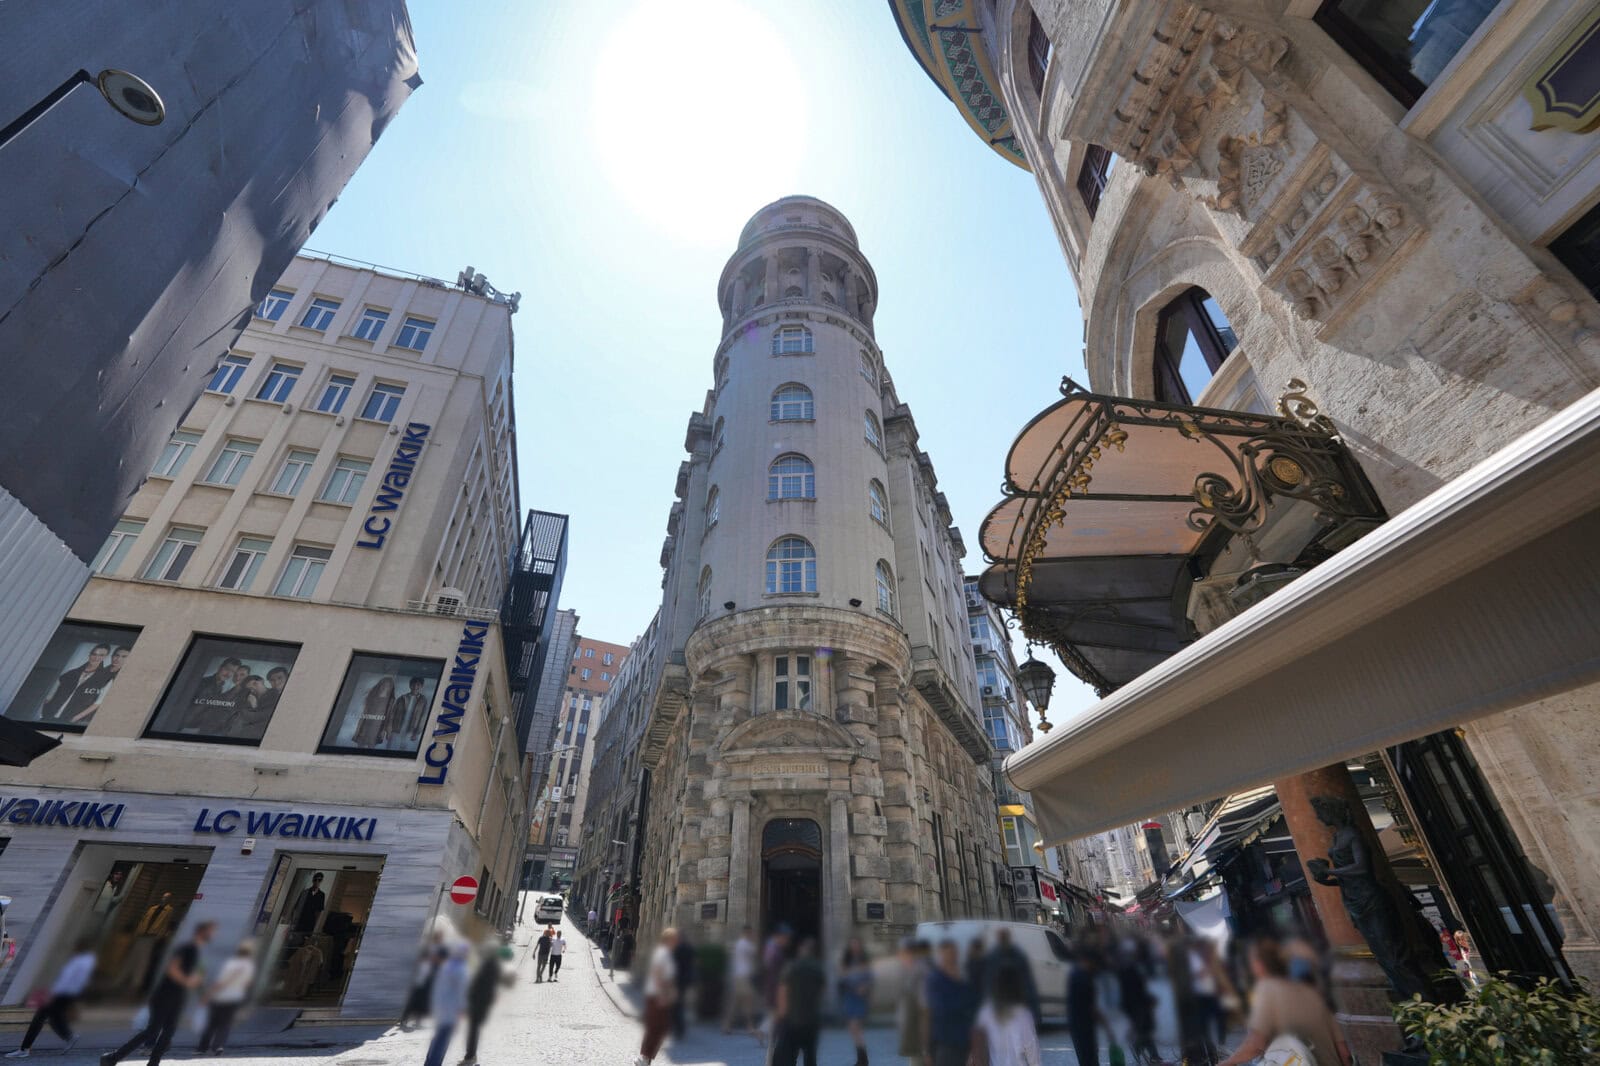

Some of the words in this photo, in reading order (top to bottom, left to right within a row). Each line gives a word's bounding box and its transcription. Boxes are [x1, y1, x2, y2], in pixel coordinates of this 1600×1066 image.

[356, 515, 391, 550] LC
[417, 742, 454, 785] LC
[193, 808, 241, 834] LC
